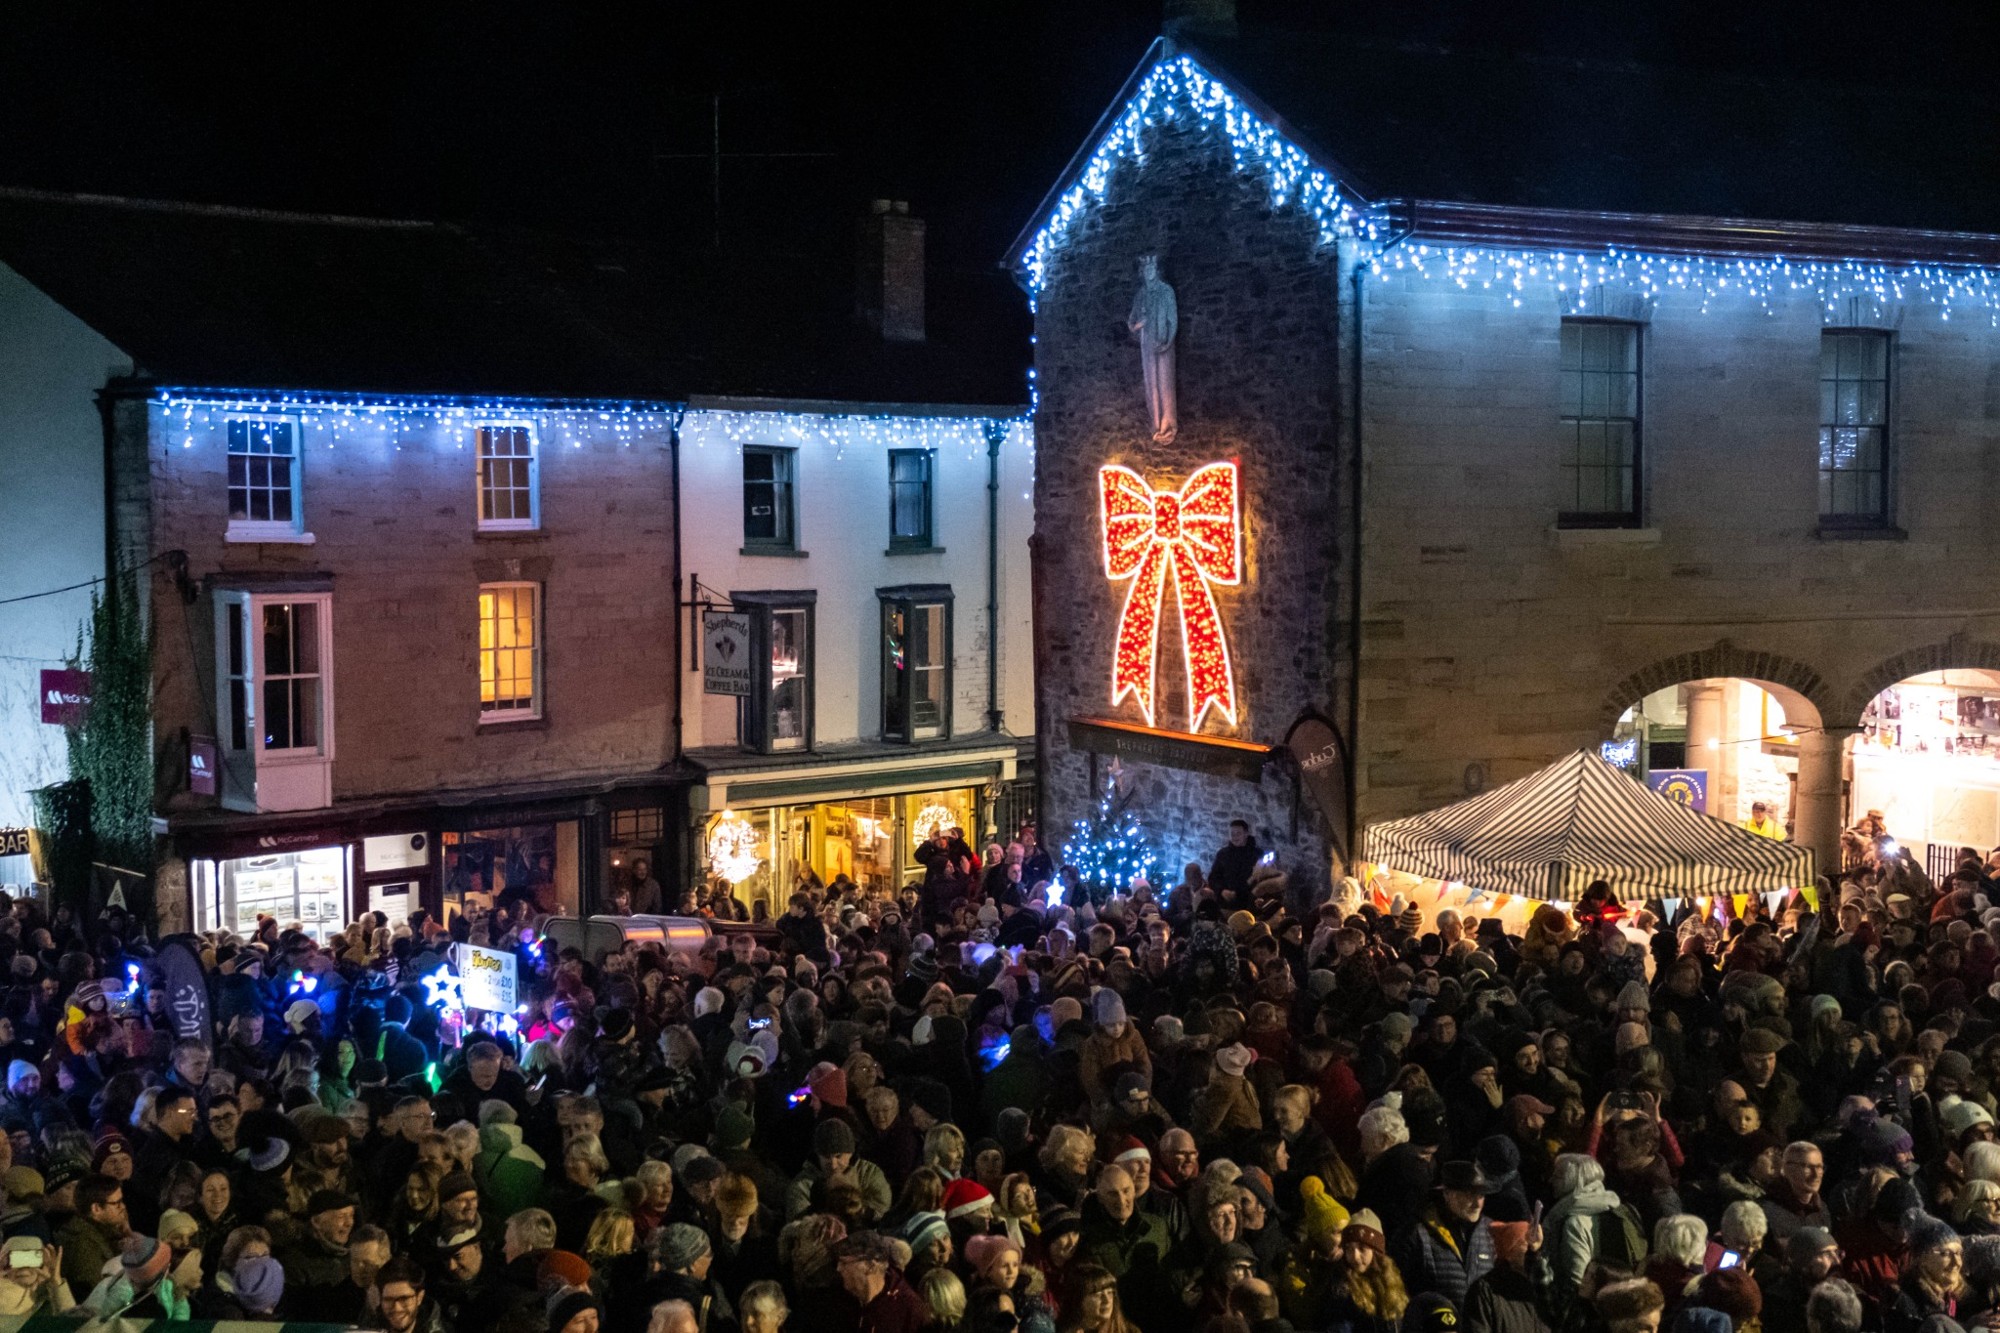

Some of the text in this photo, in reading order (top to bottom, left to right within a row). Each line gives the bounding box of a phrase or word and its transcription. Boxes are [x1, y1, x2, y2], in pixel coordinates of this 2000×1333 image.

[706, 614, 748, 637] Shepherds
[716, 667, 742, 678] CREAM
[706, 679, 750, 693] COFFEE BAR
